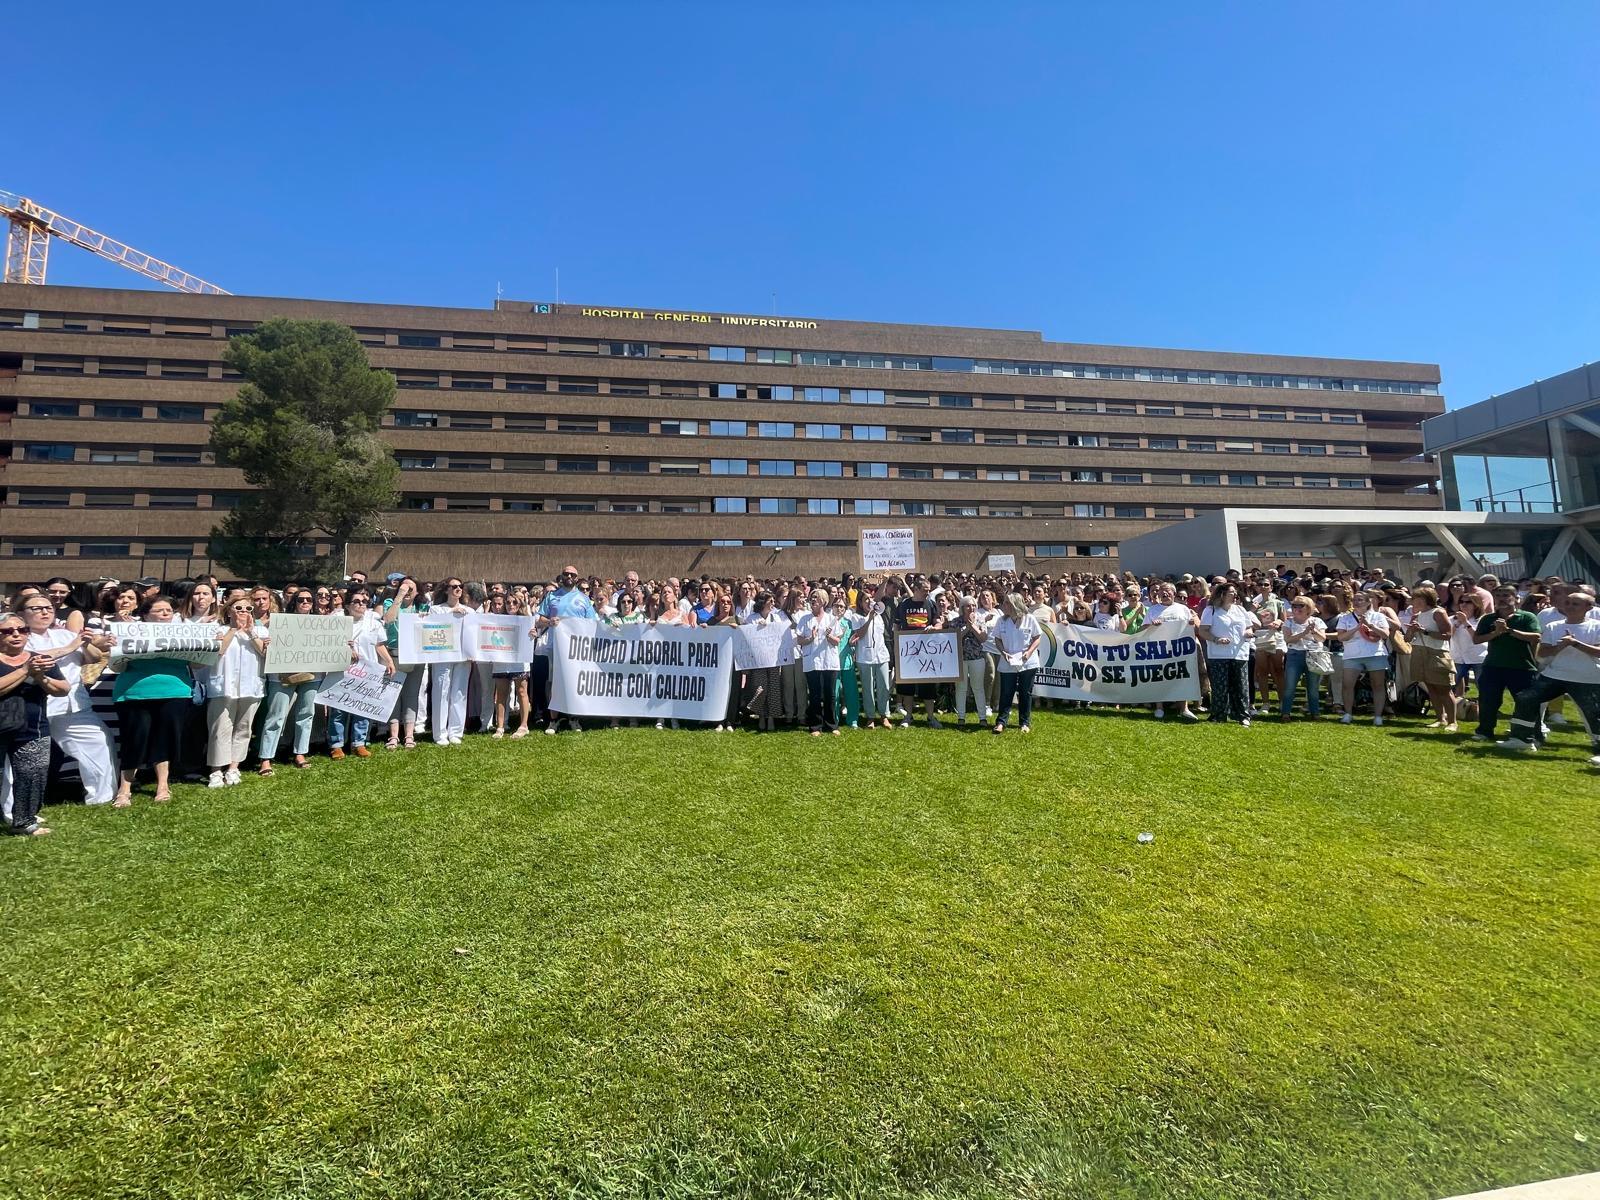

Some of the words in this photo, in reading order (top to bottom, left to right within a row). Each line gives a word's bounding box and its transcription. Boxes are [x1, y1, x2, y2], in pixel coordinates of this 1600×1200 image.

[117, 624, 150, 637] LOS
[275, 617, 289, 629] LA
[296, 616, 346, 631] VOCACIÓN
[121, 638, 150, 654] EN
[154, 638, 220, 653] SANIDAD
[276, 633, 294, 647] NO
[302, 634, 347, 648] JUSTIFICA
[568, 635, 627, 665] DIGNIDAD
[629, 640, 684, 667] LABORAL
[687, 642, 719, 668] PARA
[1063, 639, 1099, 661] CON
[1102, 644, 1131, 661] TU
[1135, 636, 1196, 661] SALUD
[269, 650, 282, 664] LA
[284, 650, 348, 664] EXPLOTACIÓN
[1045, 667, 1070, 677] DEFENSA
[1071, 662, 1097, 681] NO
[1101, 665, 1126, 683] SE
[1130, 660, 1190, 687] JUEGA
[577, 670, 623, 698] CUIDAR
[627, 673, 652, 699] CON
[656, 674, 706, 701] CALIDAD
[1038, 676, 1067, 686] ALMANSA
